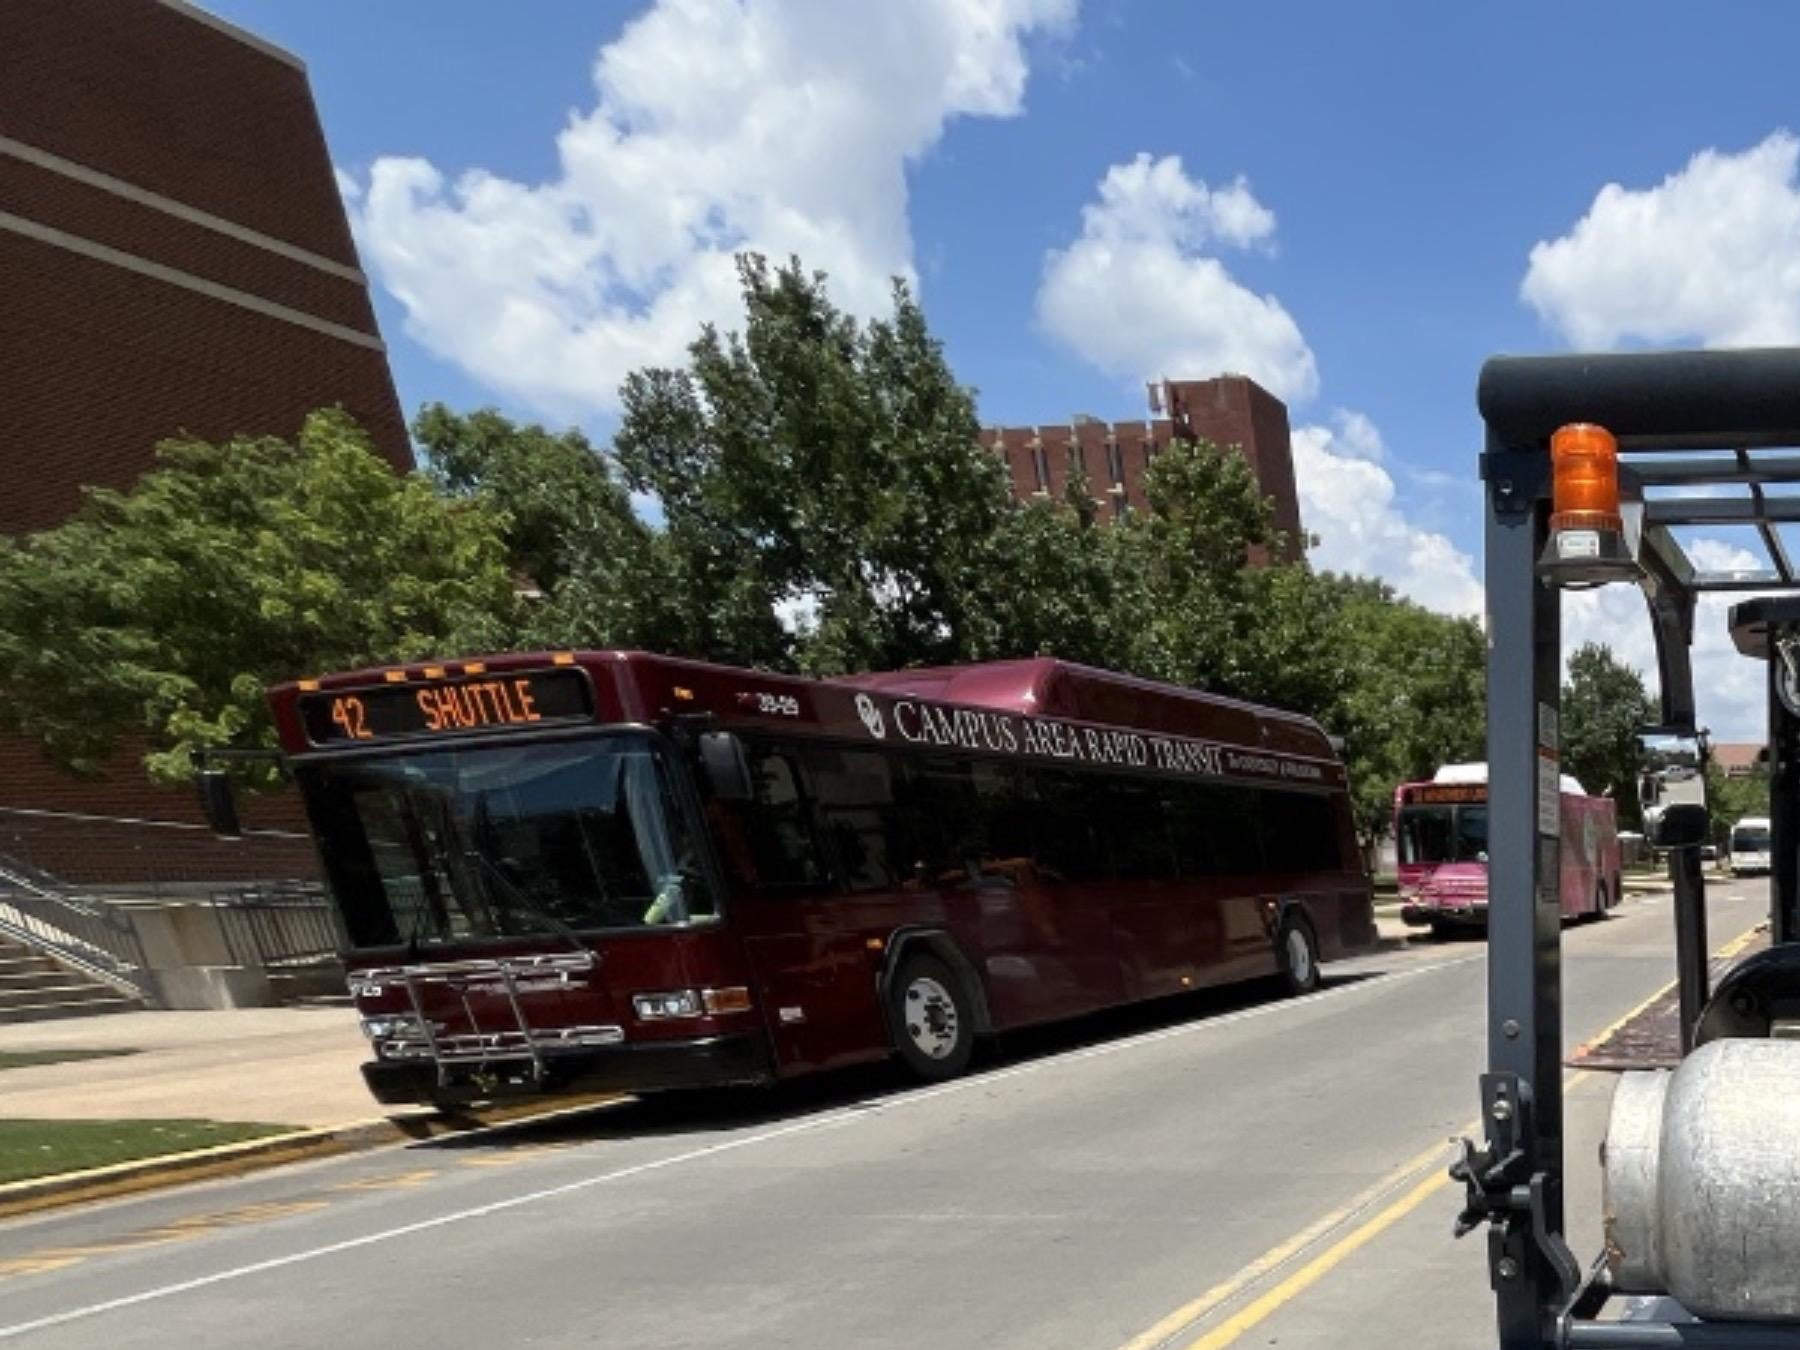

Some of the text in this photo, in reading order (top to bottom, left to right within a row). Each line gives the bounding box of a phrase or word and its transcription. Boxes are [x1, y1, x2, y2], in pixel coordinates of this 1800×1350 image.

[331, 680, 542, 740] 42 SHUTTLE
[893, 701, 1018, 754] CAMPUS
[1022, 718, 1081, 760] AREA
[1083, 726, 1148, 767] RAPID
[1153, 740, 1224, 776] TRANSIT
